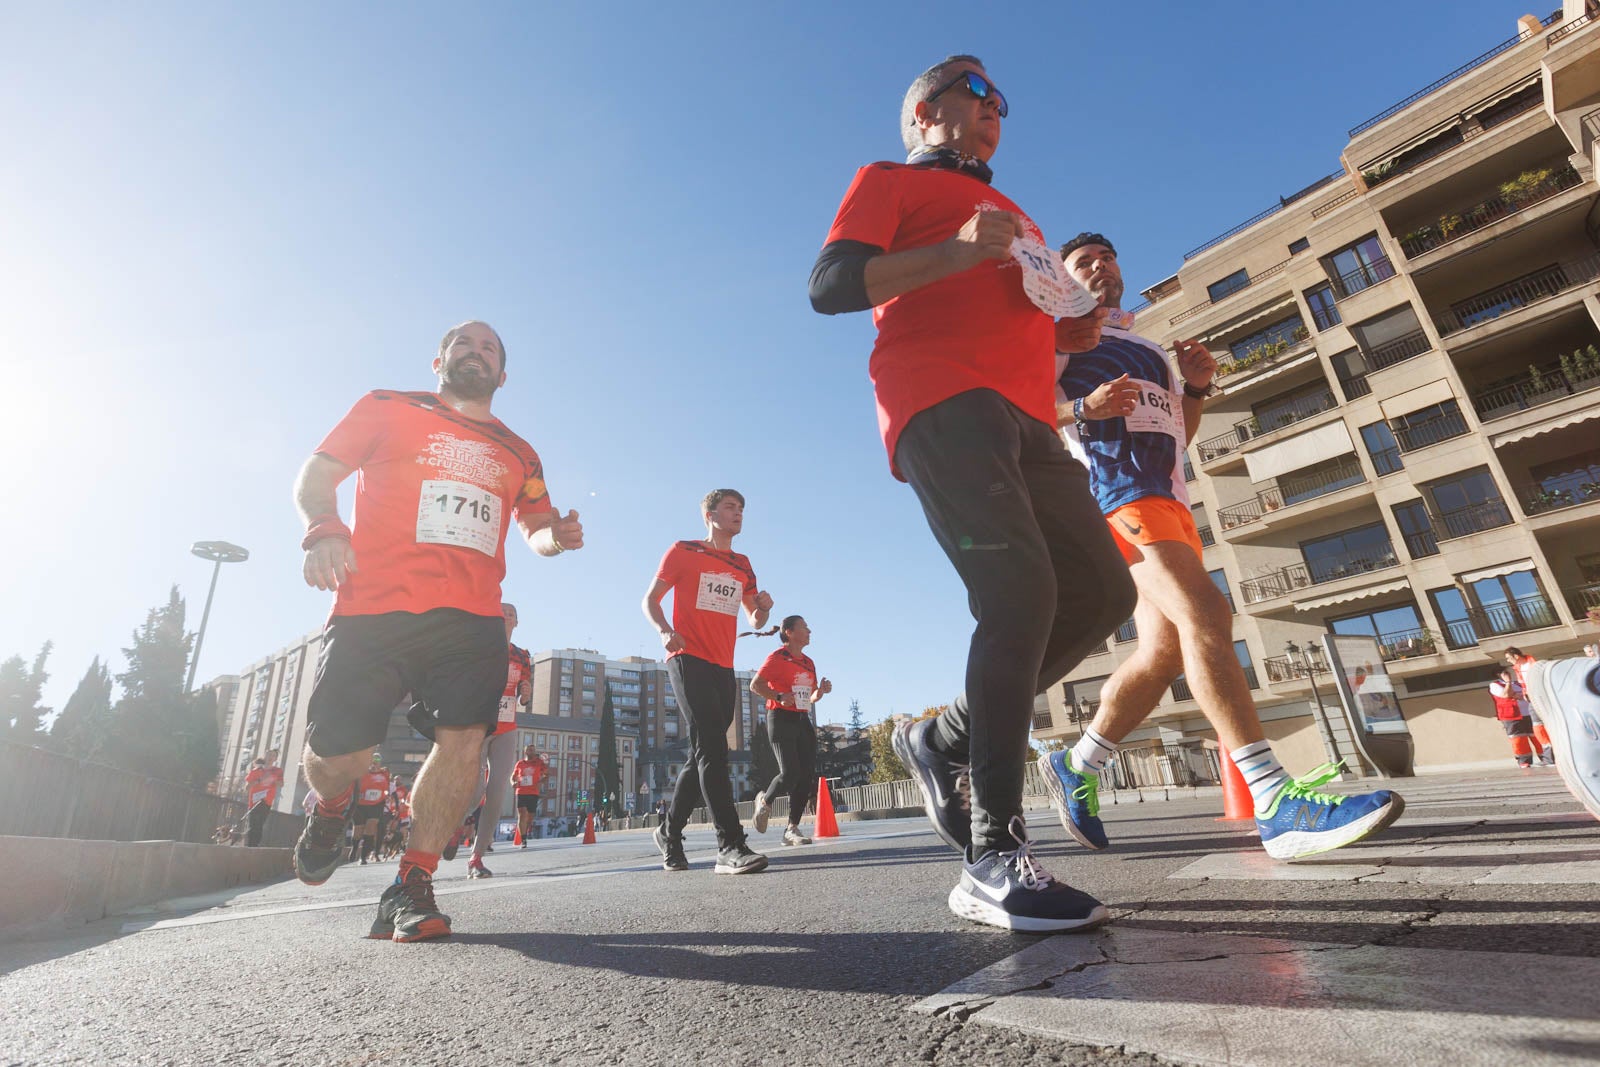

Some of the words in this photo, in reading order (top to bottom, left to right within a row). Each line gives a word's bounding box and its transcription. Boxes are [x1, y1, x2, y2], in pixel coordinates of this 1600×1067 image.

[1138, 391, 1172, 417] 1624
[428, 456, 487, 479] cruzroja
[430, 442, 502, 477] carrera
[436, 494, 491, 523] 1716
[707, 582, 737, 598] 1467
